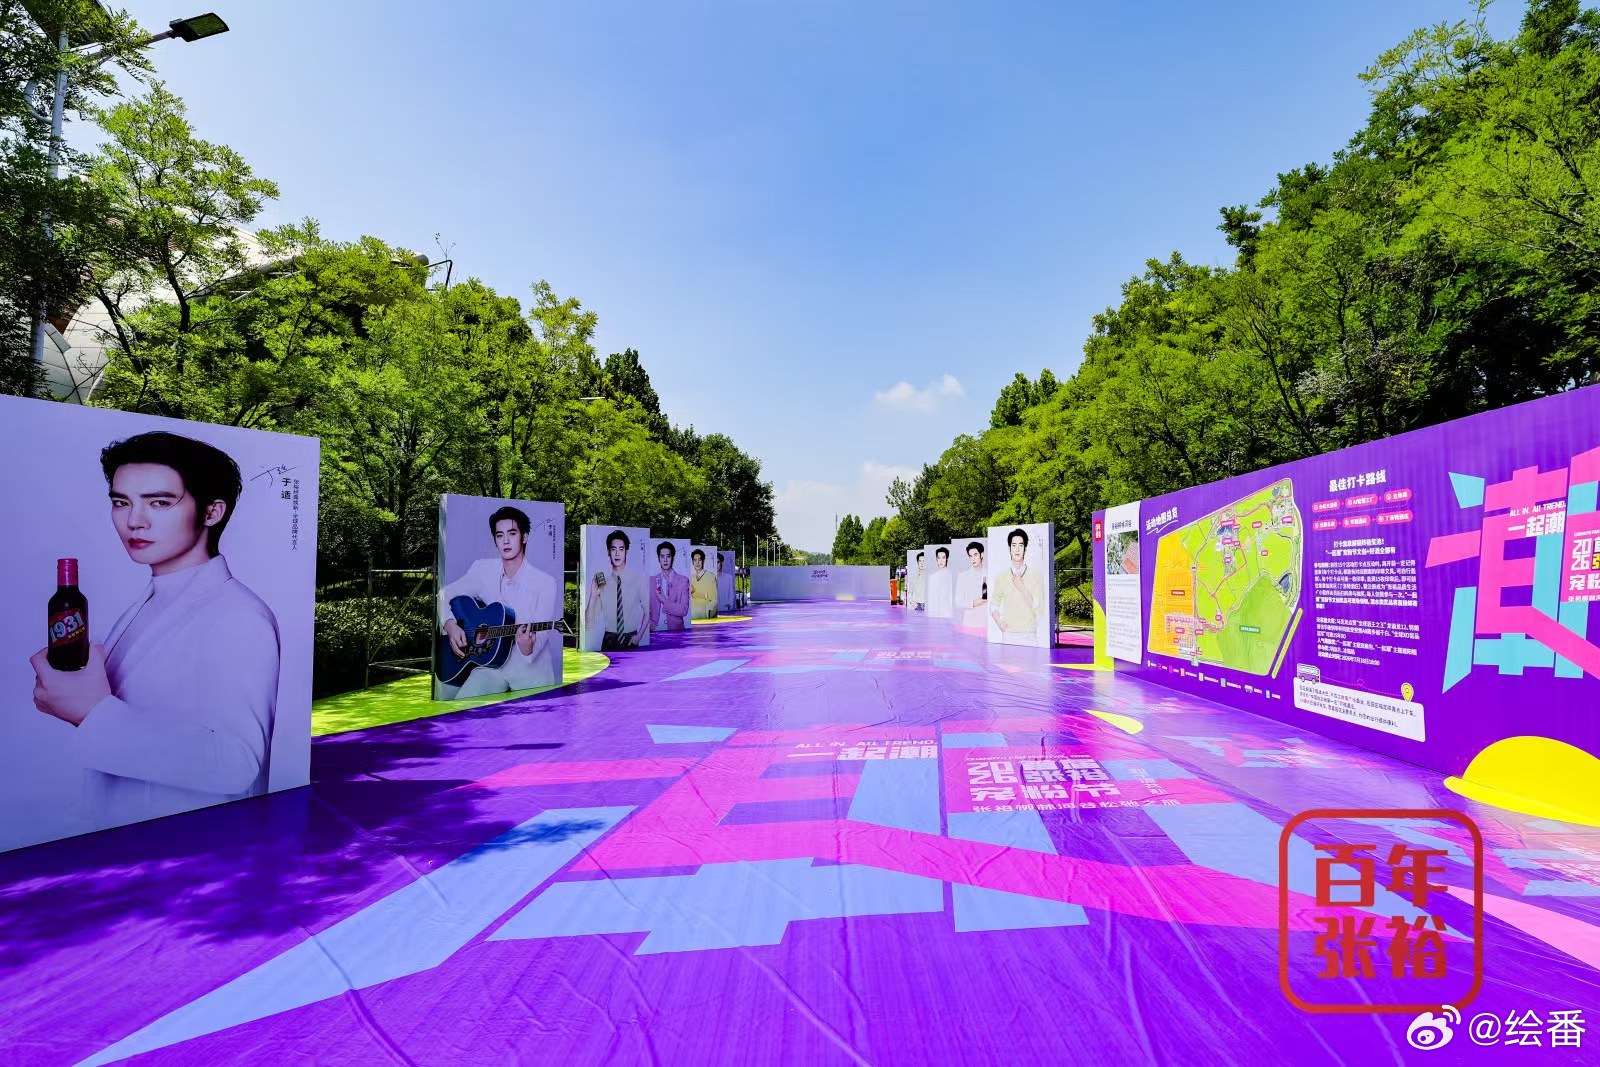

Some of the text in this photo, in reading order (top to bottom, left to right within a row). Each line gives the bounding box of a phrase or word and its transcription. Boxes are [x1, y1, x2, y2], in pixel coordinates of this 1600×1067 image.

[281, 477, 291, 499] 于适
[1329, 470, 1386, 492] 最佳打卡路线
[1510, 509, 1520, 517] ALL
[1508, 511, 1566, 537] 一起潮
[50, 611, 84, 642] 1931
[787, 745, 938, 760] 一起潮
[1025, 769, 1110, 783] 张裕
[970, 783, 1121, 802] 宠粉节
